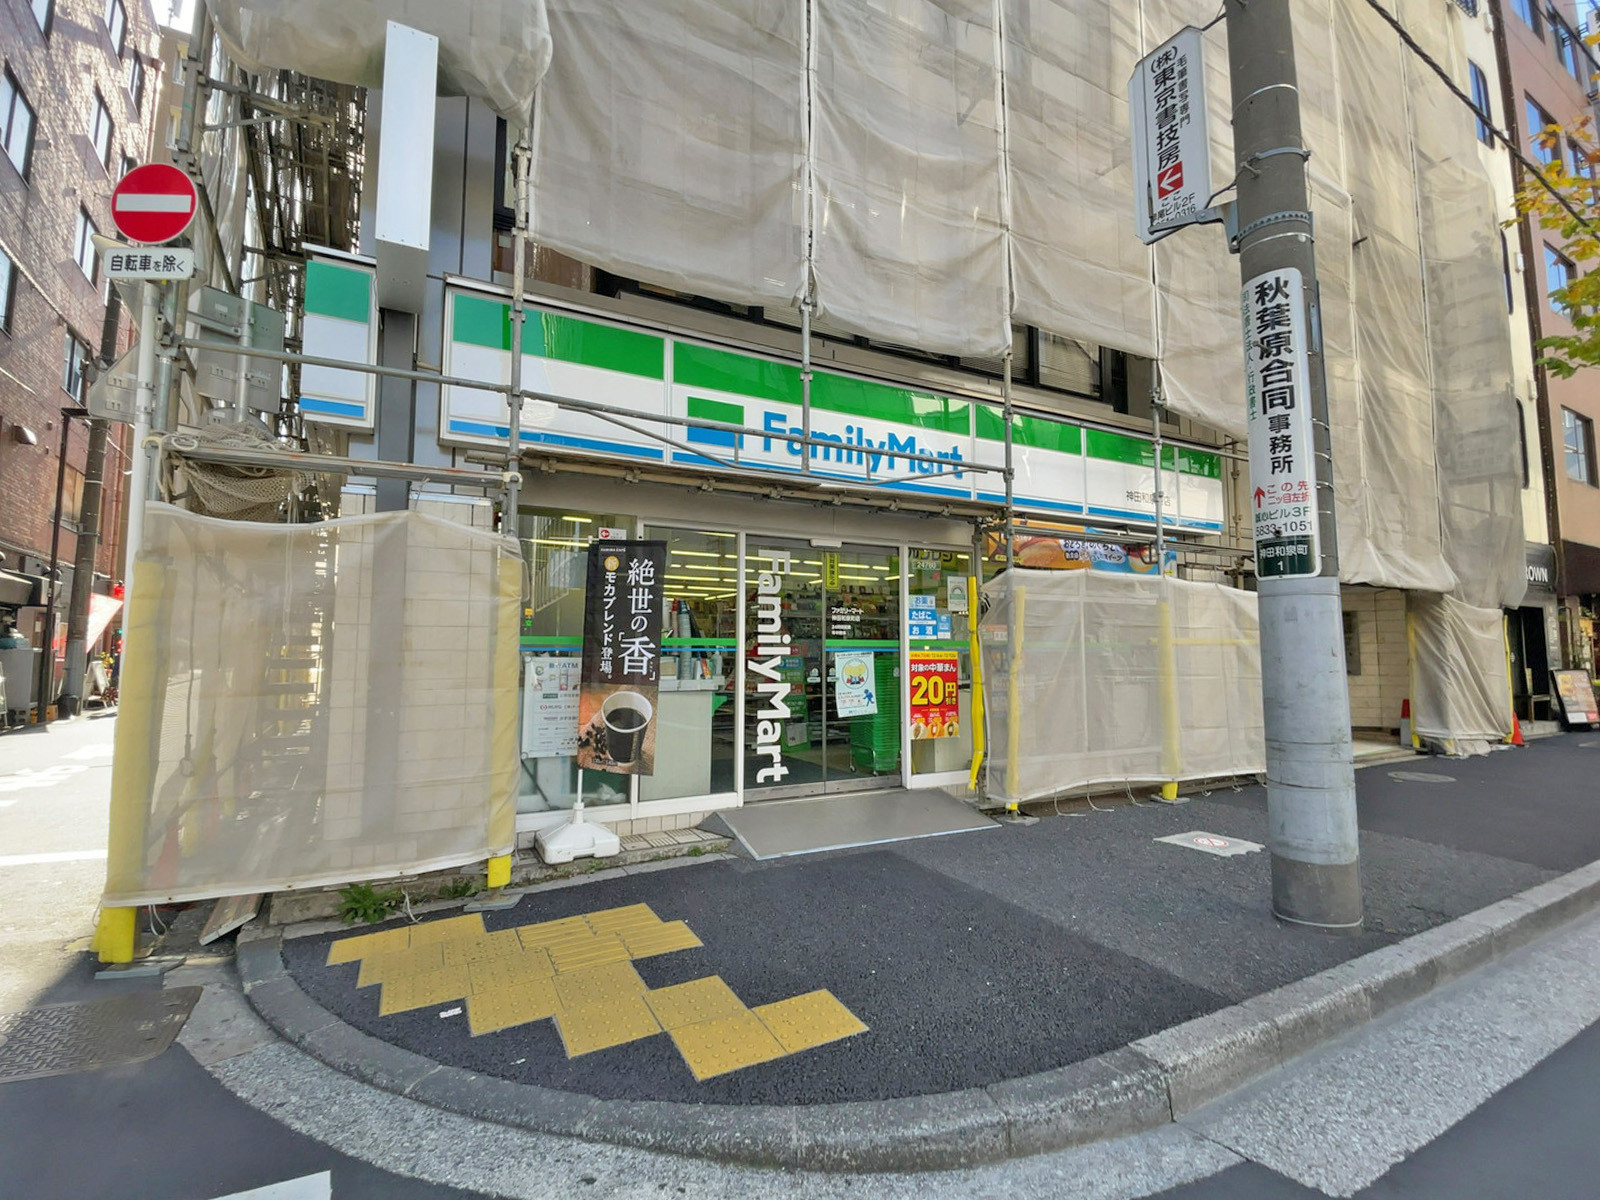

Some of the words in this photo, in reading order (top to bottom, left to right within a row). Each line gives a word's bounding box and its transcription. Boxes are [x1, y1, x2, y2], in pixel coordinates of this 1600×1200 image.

[110, 254, 185, 272] 自転車を除く
[1255, 276, 1296, 475] 秋葉原合同事務所
[763, 410, 964, 479] FamilyMart
[1267, 481, 1310, 495] この先
[1259, 544, 1309, 560] 神田和泉町
[1277, 560, 1284, 571] 1
[618, 557, 656, 681] 絶世の「香」
[911, 611, 932, 620] たばこ
[912, 626, 933, 635] お酒
[747, 549, 791, 783] FamilyMart
